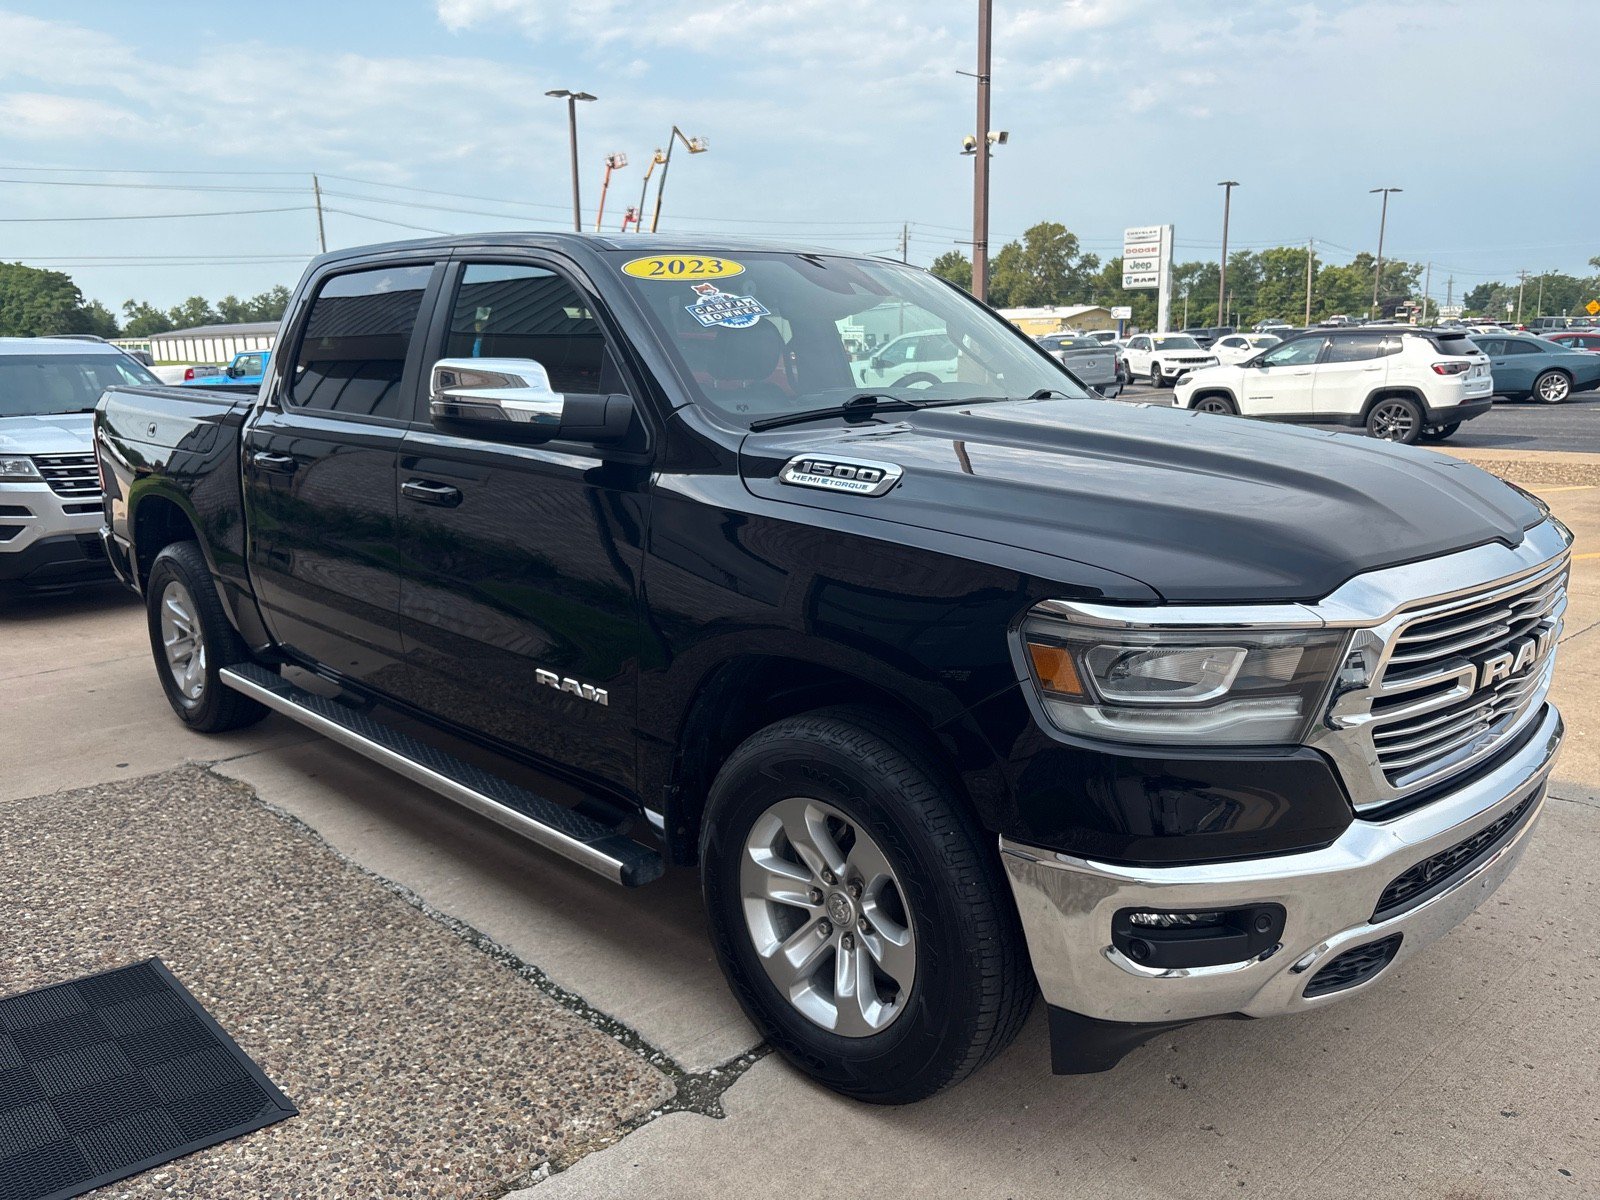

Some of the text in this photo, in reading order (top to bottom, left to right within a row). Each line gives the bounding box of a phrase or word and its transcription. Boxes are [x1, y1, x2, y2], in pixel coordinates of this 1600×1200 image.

[648, 259, 723, 276] 2023
[1129, 260, 1152, 270] Jeep
[694, 299, 754, 315] CARFAX
[712, 306, 762, 320] OWNER
[801, 461, 881, 482] 1500
[1480, 619, 1557, 688] RAM
[535, 668, 608, 706] RAM
